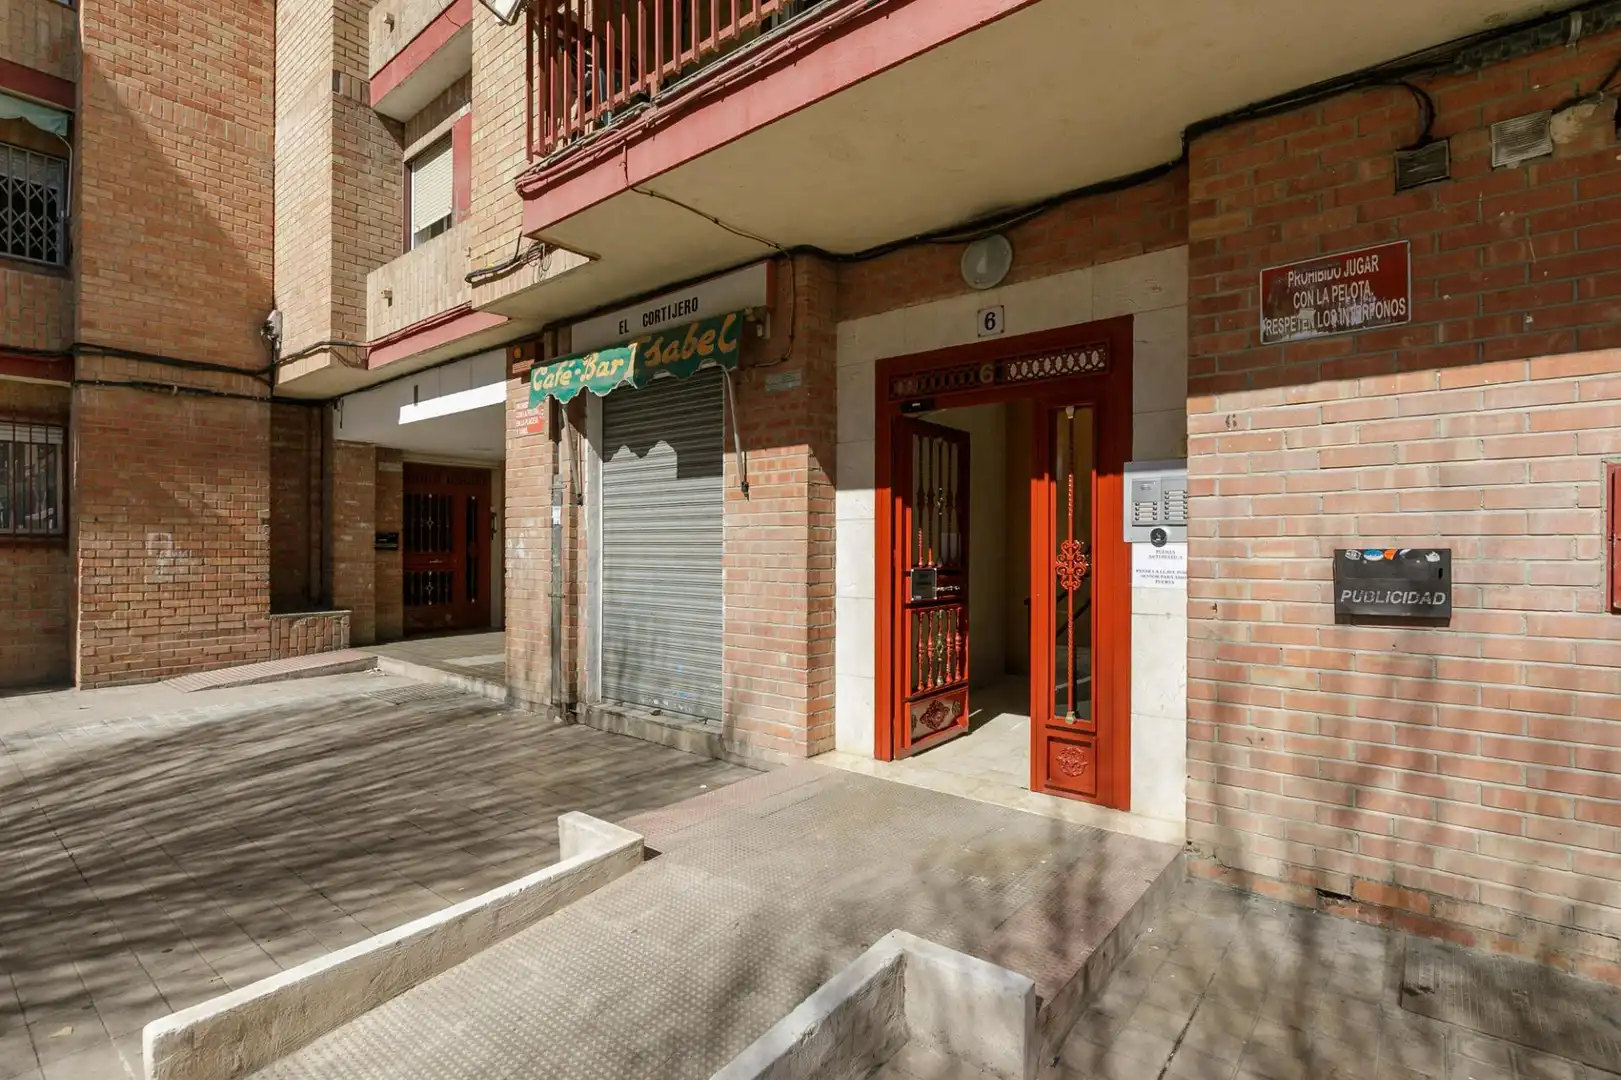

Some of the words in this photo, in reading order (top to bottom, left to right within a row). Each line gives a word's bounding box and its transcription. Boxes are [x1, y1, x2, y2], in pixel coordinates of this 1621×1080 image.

[1344, 254, 1379, 277] JUGAR
[1293, 290, 1314, 309] CON
[1317, 286, 1329, 305] LA
[619, 318, 629, 335] EL
[642, 297, 698, 328] CORTIJERO
[984, 312, 996, 330] 6
[979, 363, 994, 384] 6
[1340, 589, 1446, 605] PUBLICIDAD
